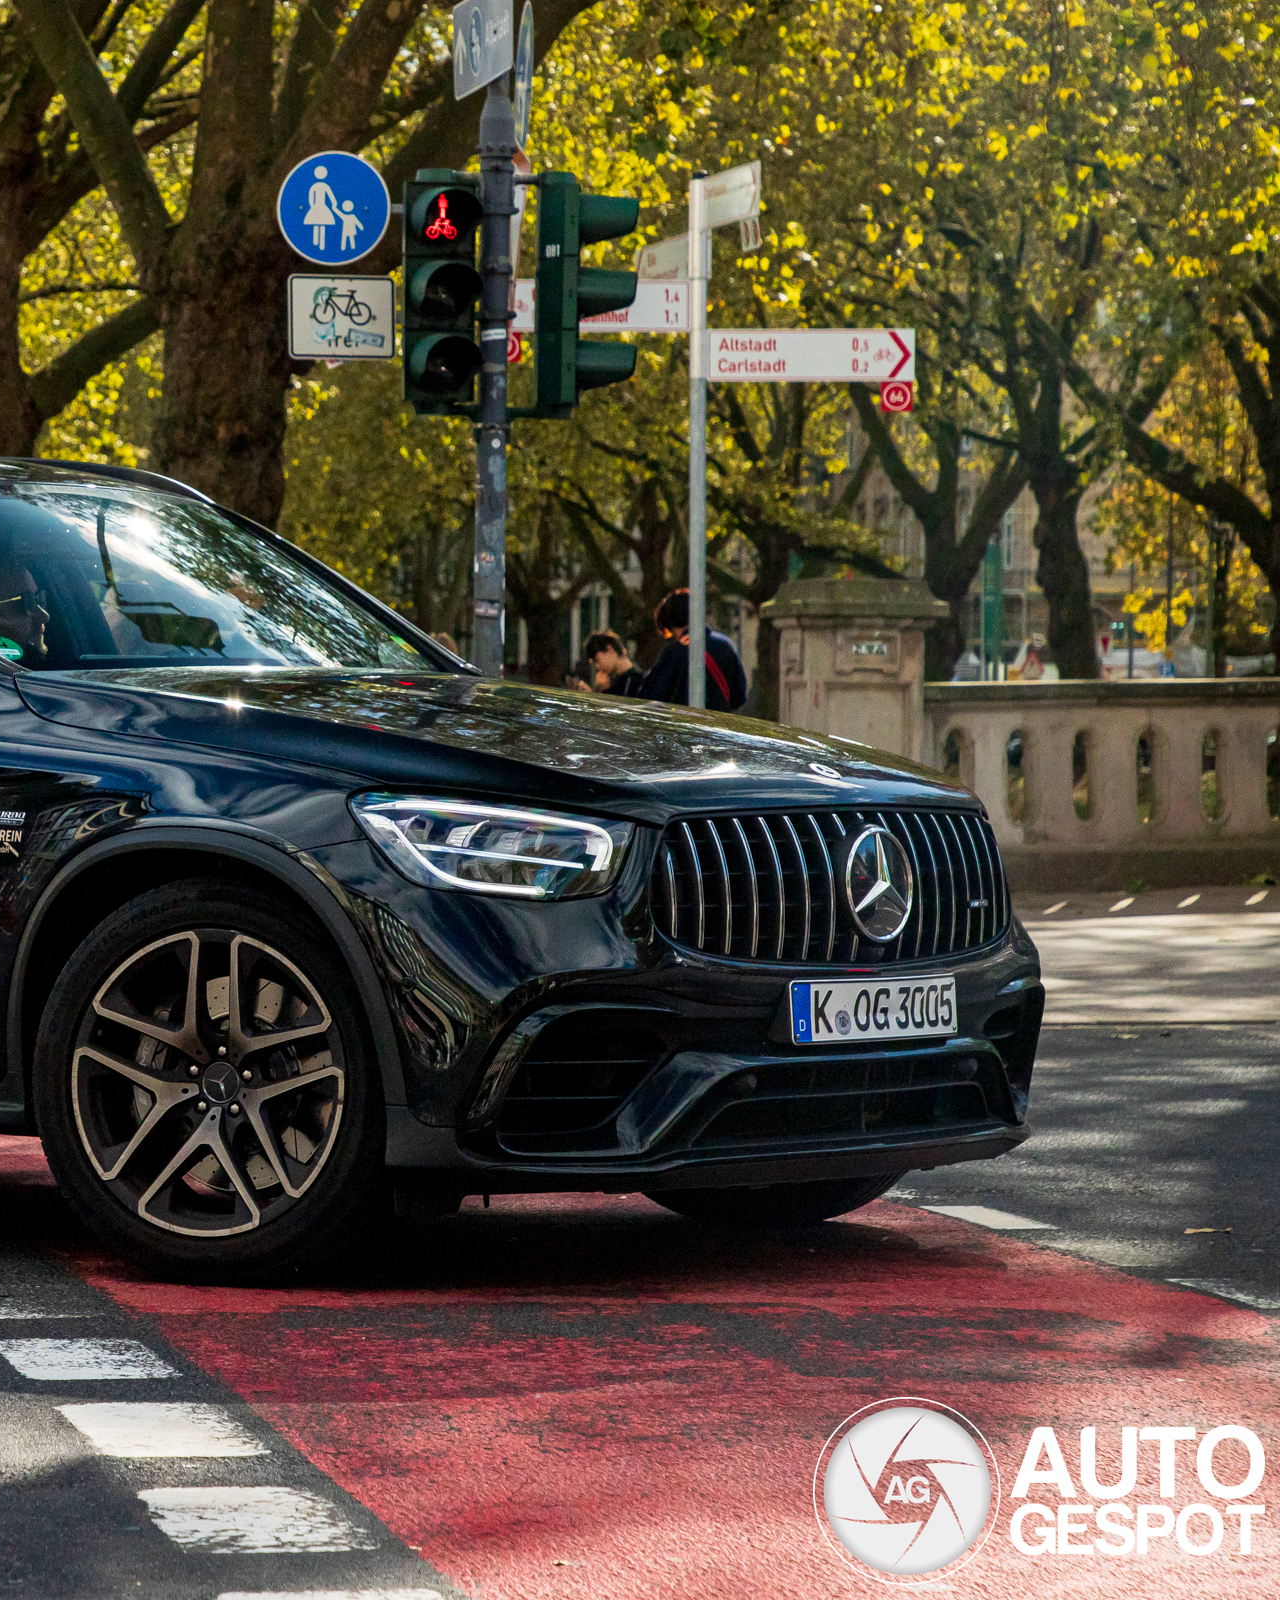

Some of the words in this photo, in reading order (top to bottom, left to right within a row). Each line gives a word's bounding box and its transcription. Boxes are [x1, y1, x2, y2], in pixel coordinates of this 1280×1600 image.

[718, 337, 777, 352] Altstadt
[717, 358, 786, 373] Carlstadt
[813, 989, 834, 1034] K
[853, 987, 891, 1032] OG
[895, 984, 954, 1029] 3005
[798, 1019, 807, 1032] D
